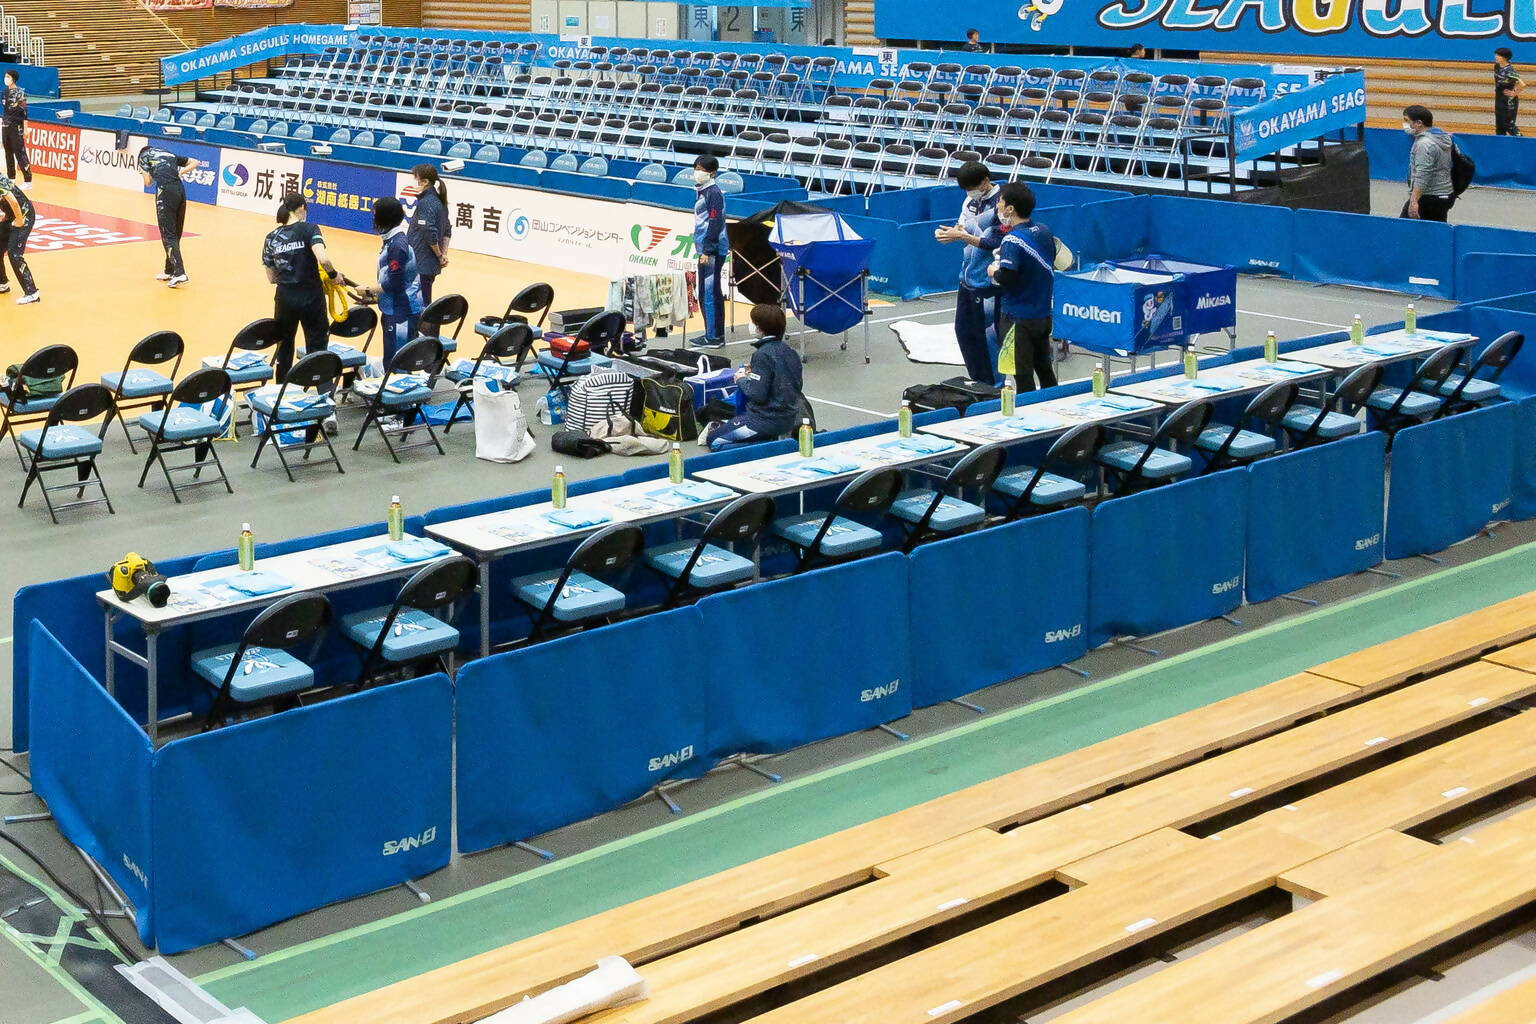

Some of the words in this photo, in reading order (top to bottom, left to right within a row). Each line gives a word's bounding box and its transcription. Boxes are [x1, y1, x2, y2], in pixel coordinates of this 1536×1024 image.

[694, 6, 709, 28] 東
[727, 6, 740, 32] 2
[181, 48, 238, 73] OKAYAMA
[240, 34, 290, 55] SEAGULLS
[292, 32, 348, 45] HOMEGAME
[882, 51, 894, 63] 東
[1258, 99, 1327, 139] OKAYAMA
[26, 127, 76, 152] TURKISH
[456, 202, 502, 233] 萬吉
[532, 218, 624, 244] 岡山コンベンションセンター
[1062, 302, 1121, 325] molten
[1212, 576, 1240, 595] SAN-EI
[1044, 623, 1082, 645] SAN-EI
[861, 679, 900, 704] SAN-EI
[648, 745, 694, 773] SAN-EI
[382, 826, 438, 857] SAN-EI
